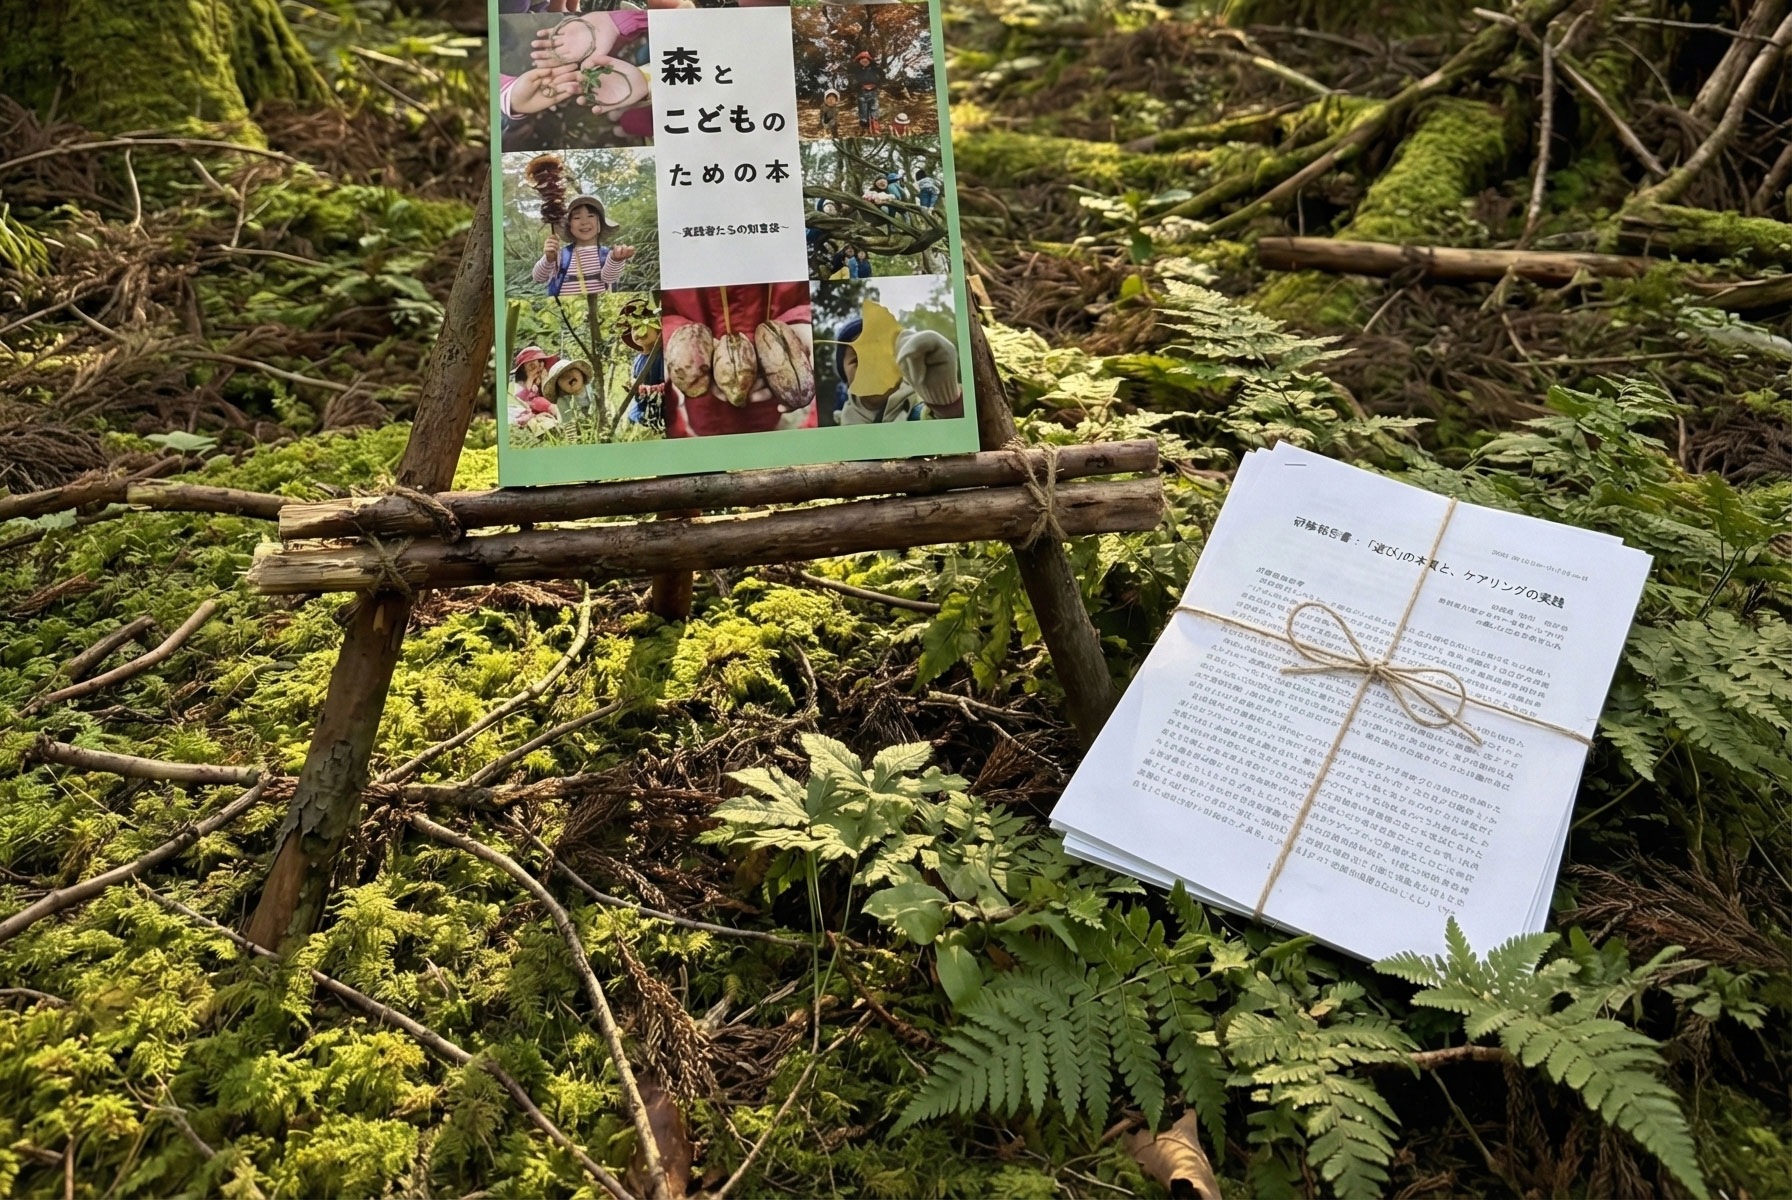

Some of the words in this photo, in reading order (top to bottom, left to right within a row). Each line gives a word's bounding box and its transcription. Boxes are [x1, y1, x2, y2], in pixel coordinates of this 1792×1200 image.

[661, 46, 734, 86] 森と
[663, 103, 786, 135] こどもの
[669, 159, 790, 187] ための本
